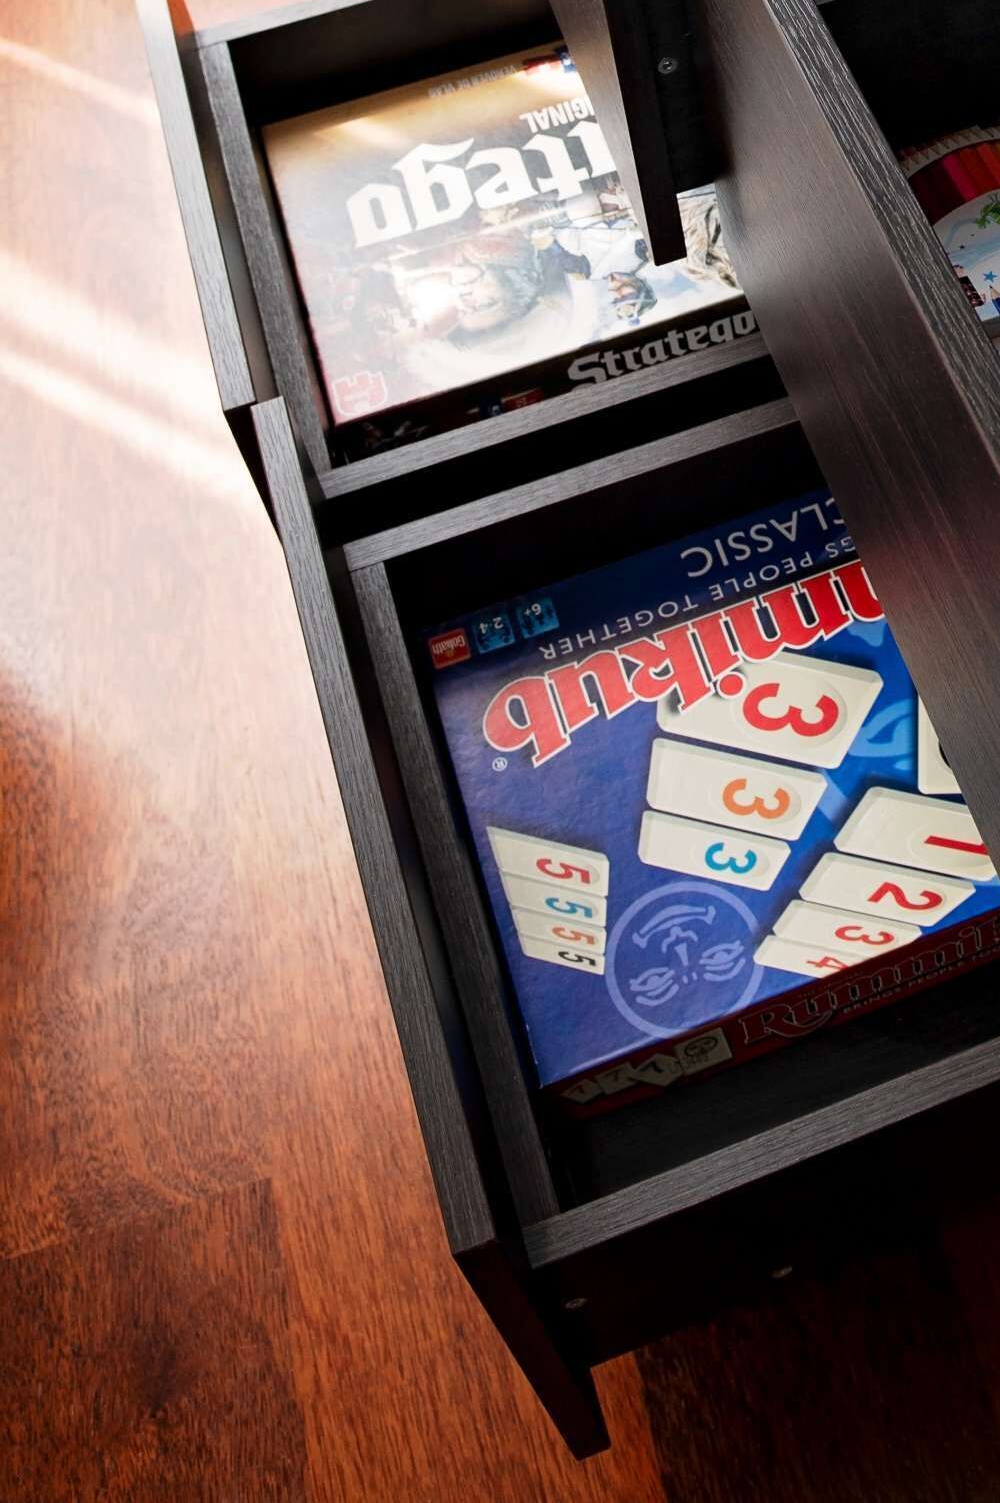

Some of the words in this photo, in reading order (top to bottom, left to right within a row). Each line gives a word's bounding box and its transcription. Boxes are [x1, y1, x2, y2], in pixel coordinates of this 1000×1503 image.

[568, 312, 759, 389] Stratego
[709, 550, 814, 601] PEOPLE
[523, 602, 542, 617] 6+
[539, 594, 699, 659] TOGETHER
[431, 635, 466, 656] Goliath
[742, 681, 839, 738] 3
[722, 777, 791, 821] 3
[535, 857, 592, 885] 5
[704, 841, 757, 875] 3
[544, 896, 593, 920] 5
[867, 881, 943, 912] 2
[551, 926, 596, 947] 5
[834, 925, 895, 948] 3
[558, 950, 597, 968] 5
